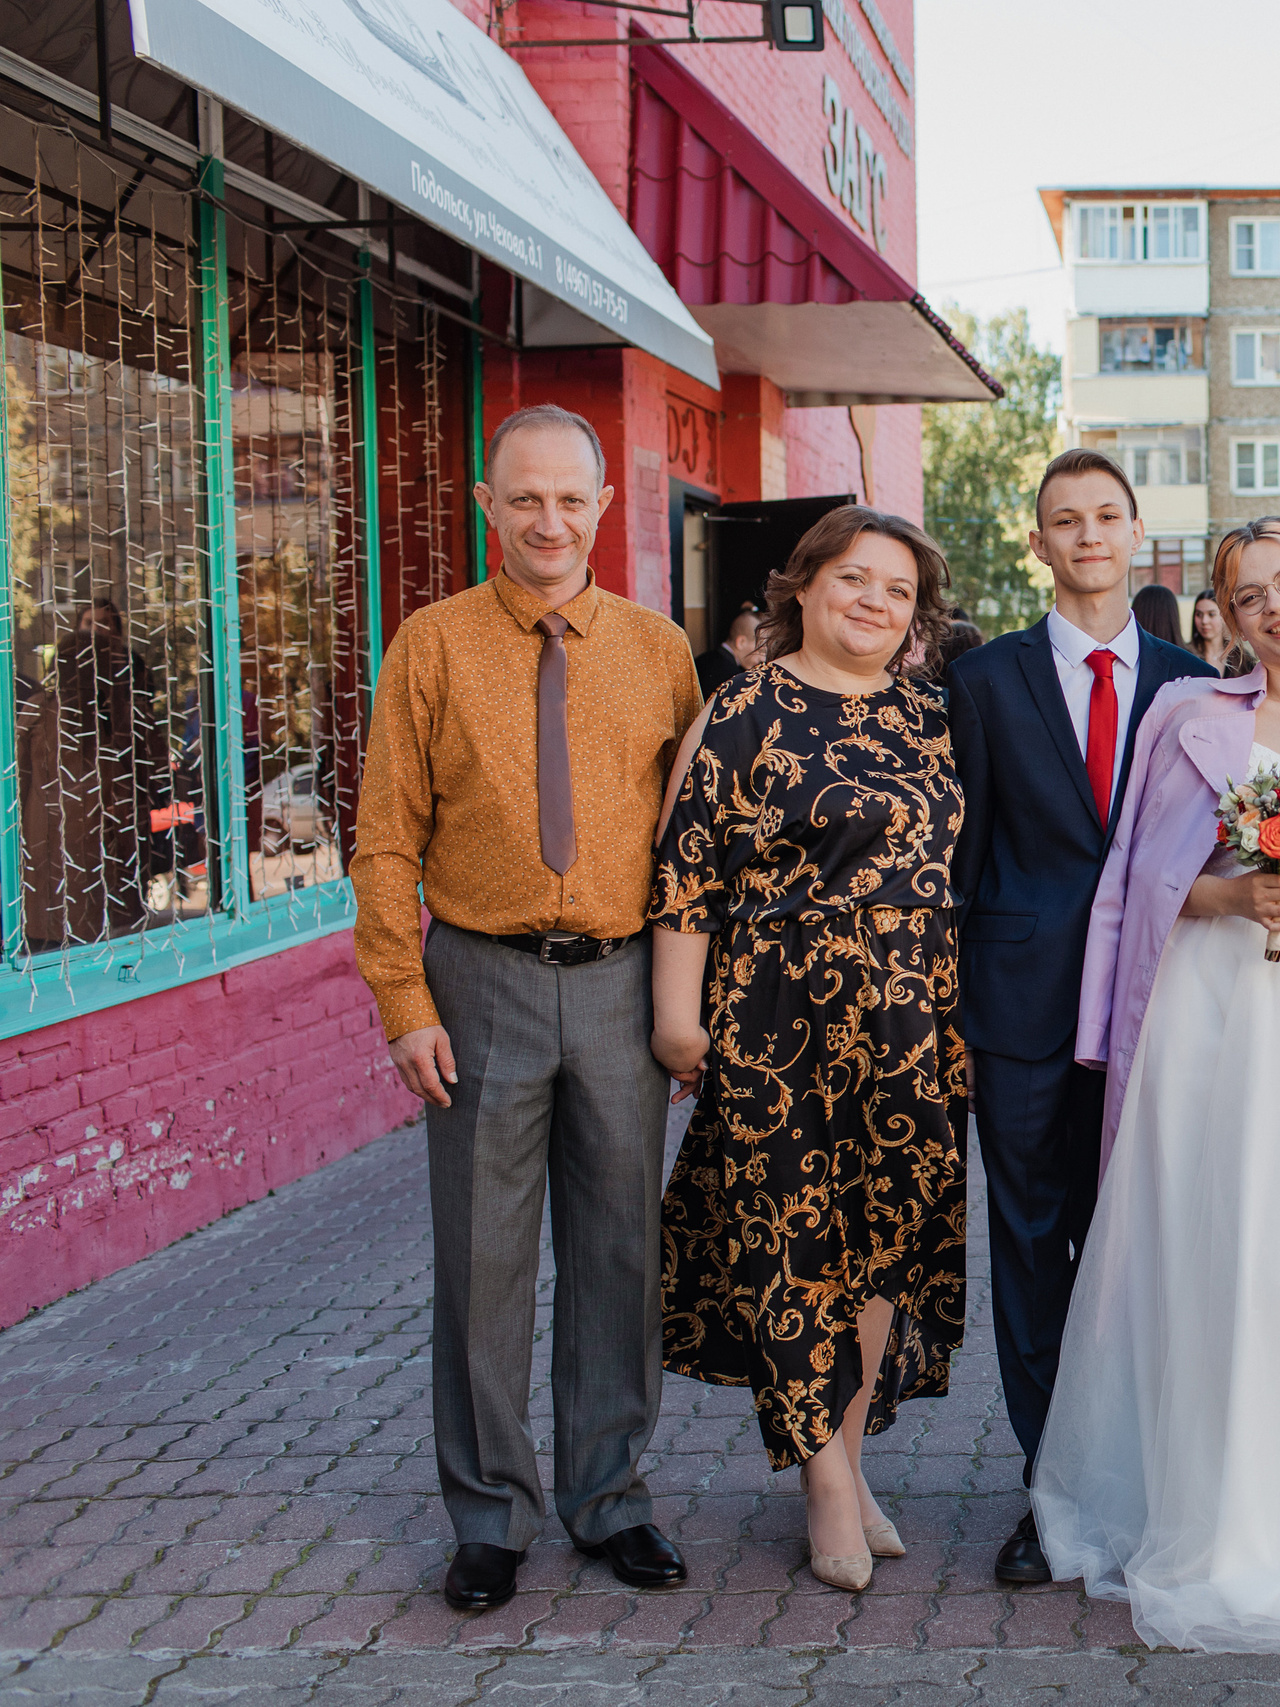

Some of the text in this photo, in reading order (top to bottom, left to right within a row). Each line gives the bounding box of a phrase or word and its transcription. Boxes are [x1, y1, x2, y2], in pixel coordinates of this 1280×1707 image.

[411, 160, 473, 232] Подольск,
[823, 73, 887, 254] ЗАГС
[555, 255, 563, 284] 8
